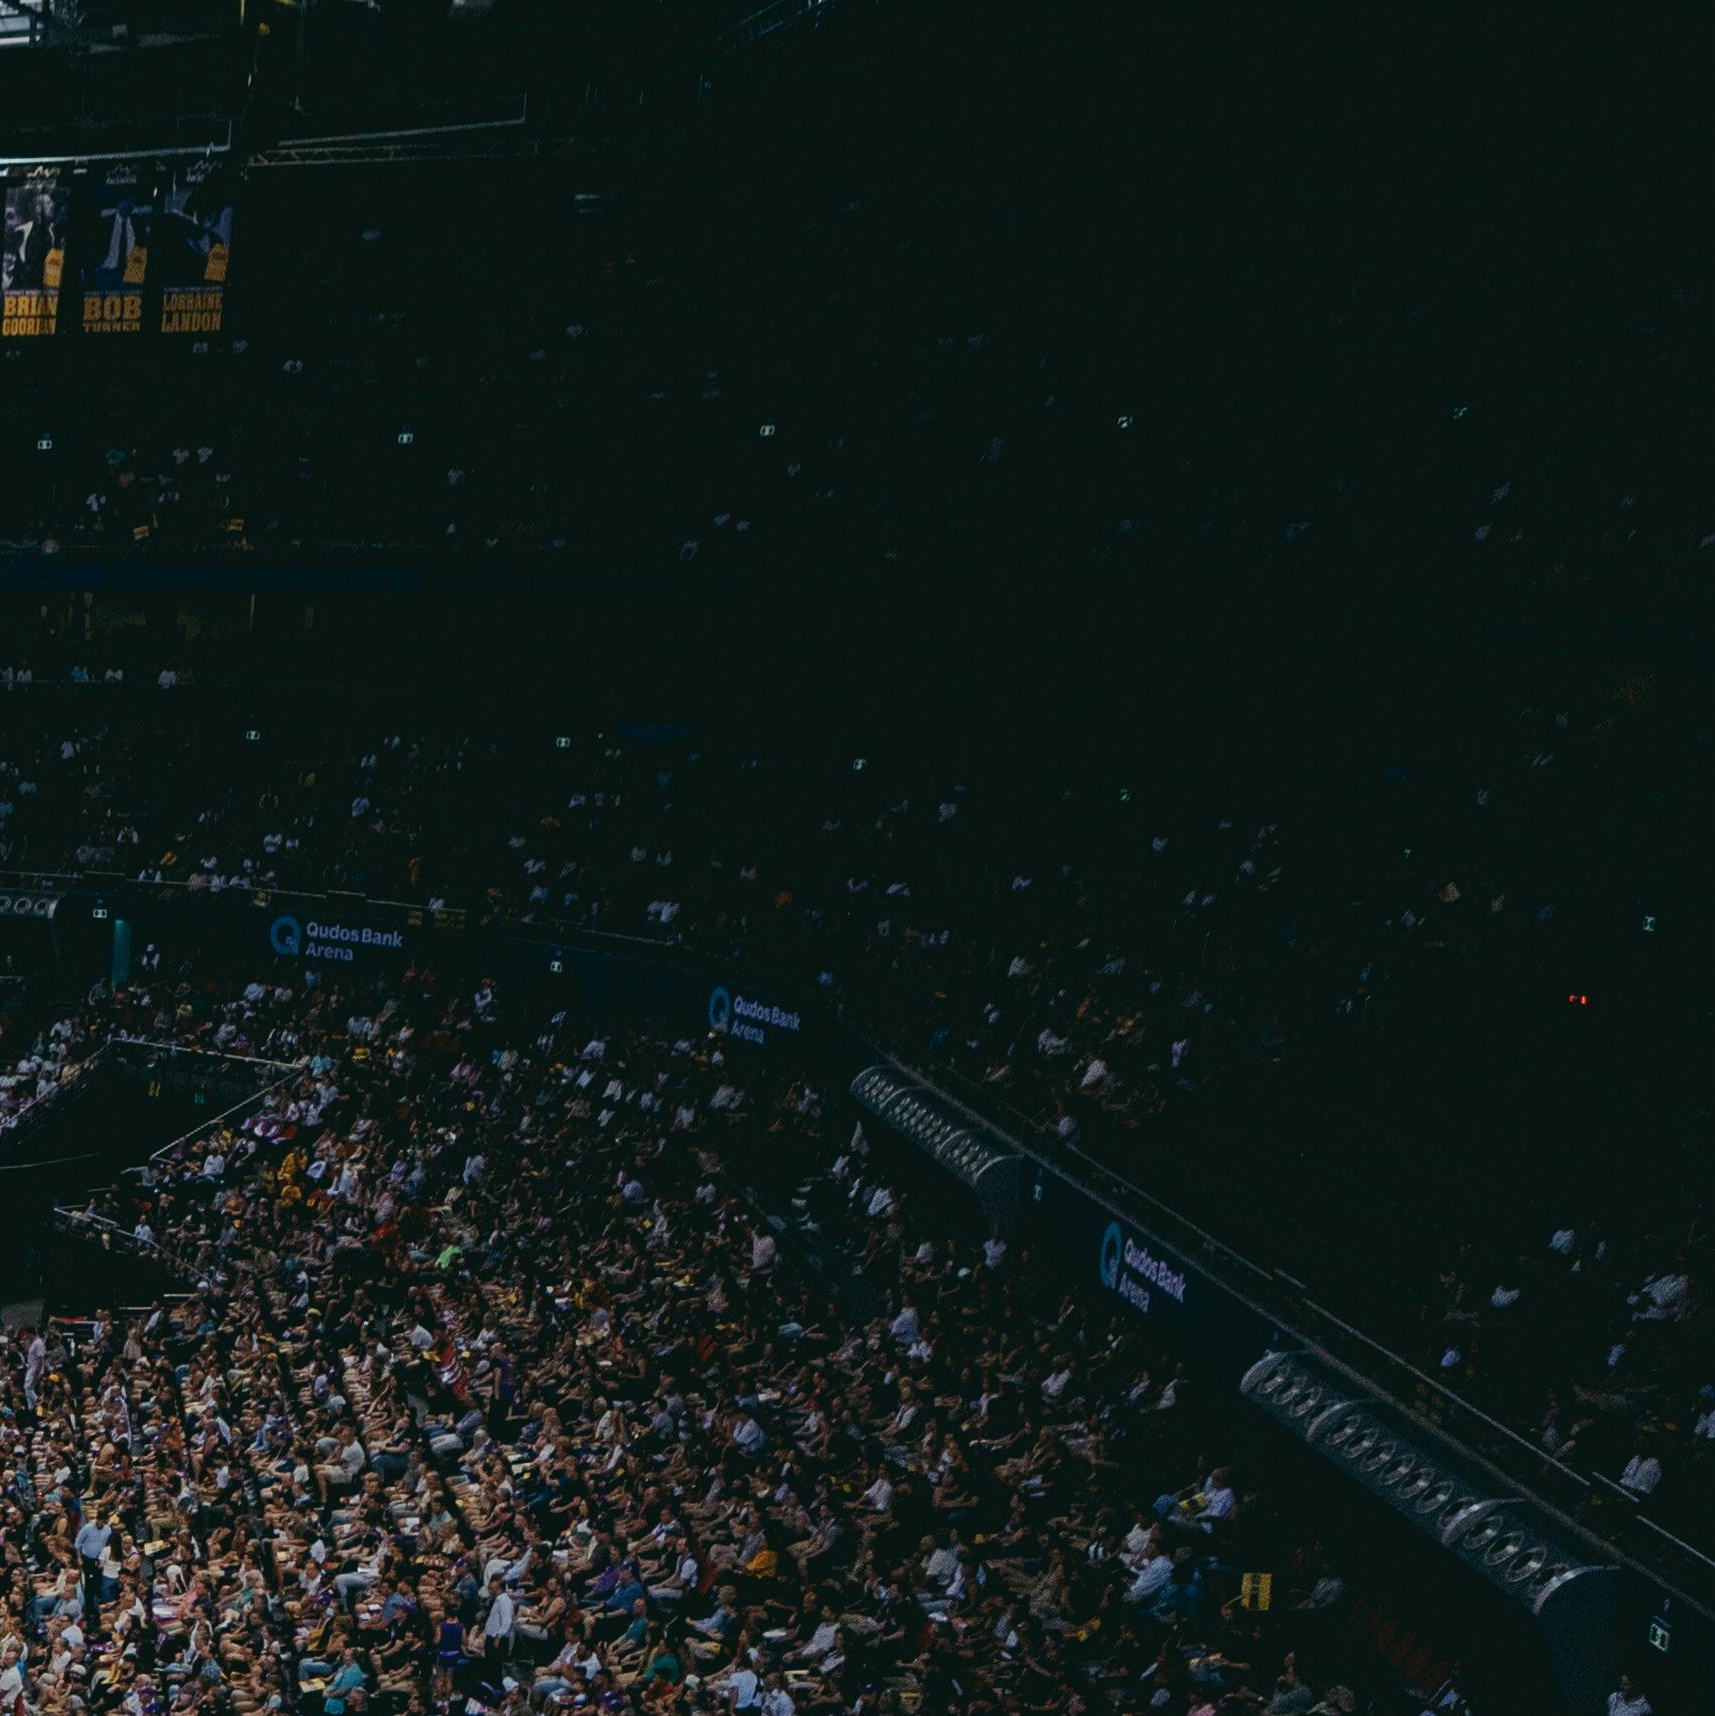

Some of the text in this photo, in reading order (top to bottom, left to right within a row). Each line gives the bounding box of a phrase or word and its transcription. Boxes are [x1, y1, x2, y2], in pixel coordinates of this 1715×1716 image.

[83, 295, 142, 320] BOB
[306, 921, 404, 948] Qudos Bank
[305, 942, 354, 962] Arena
